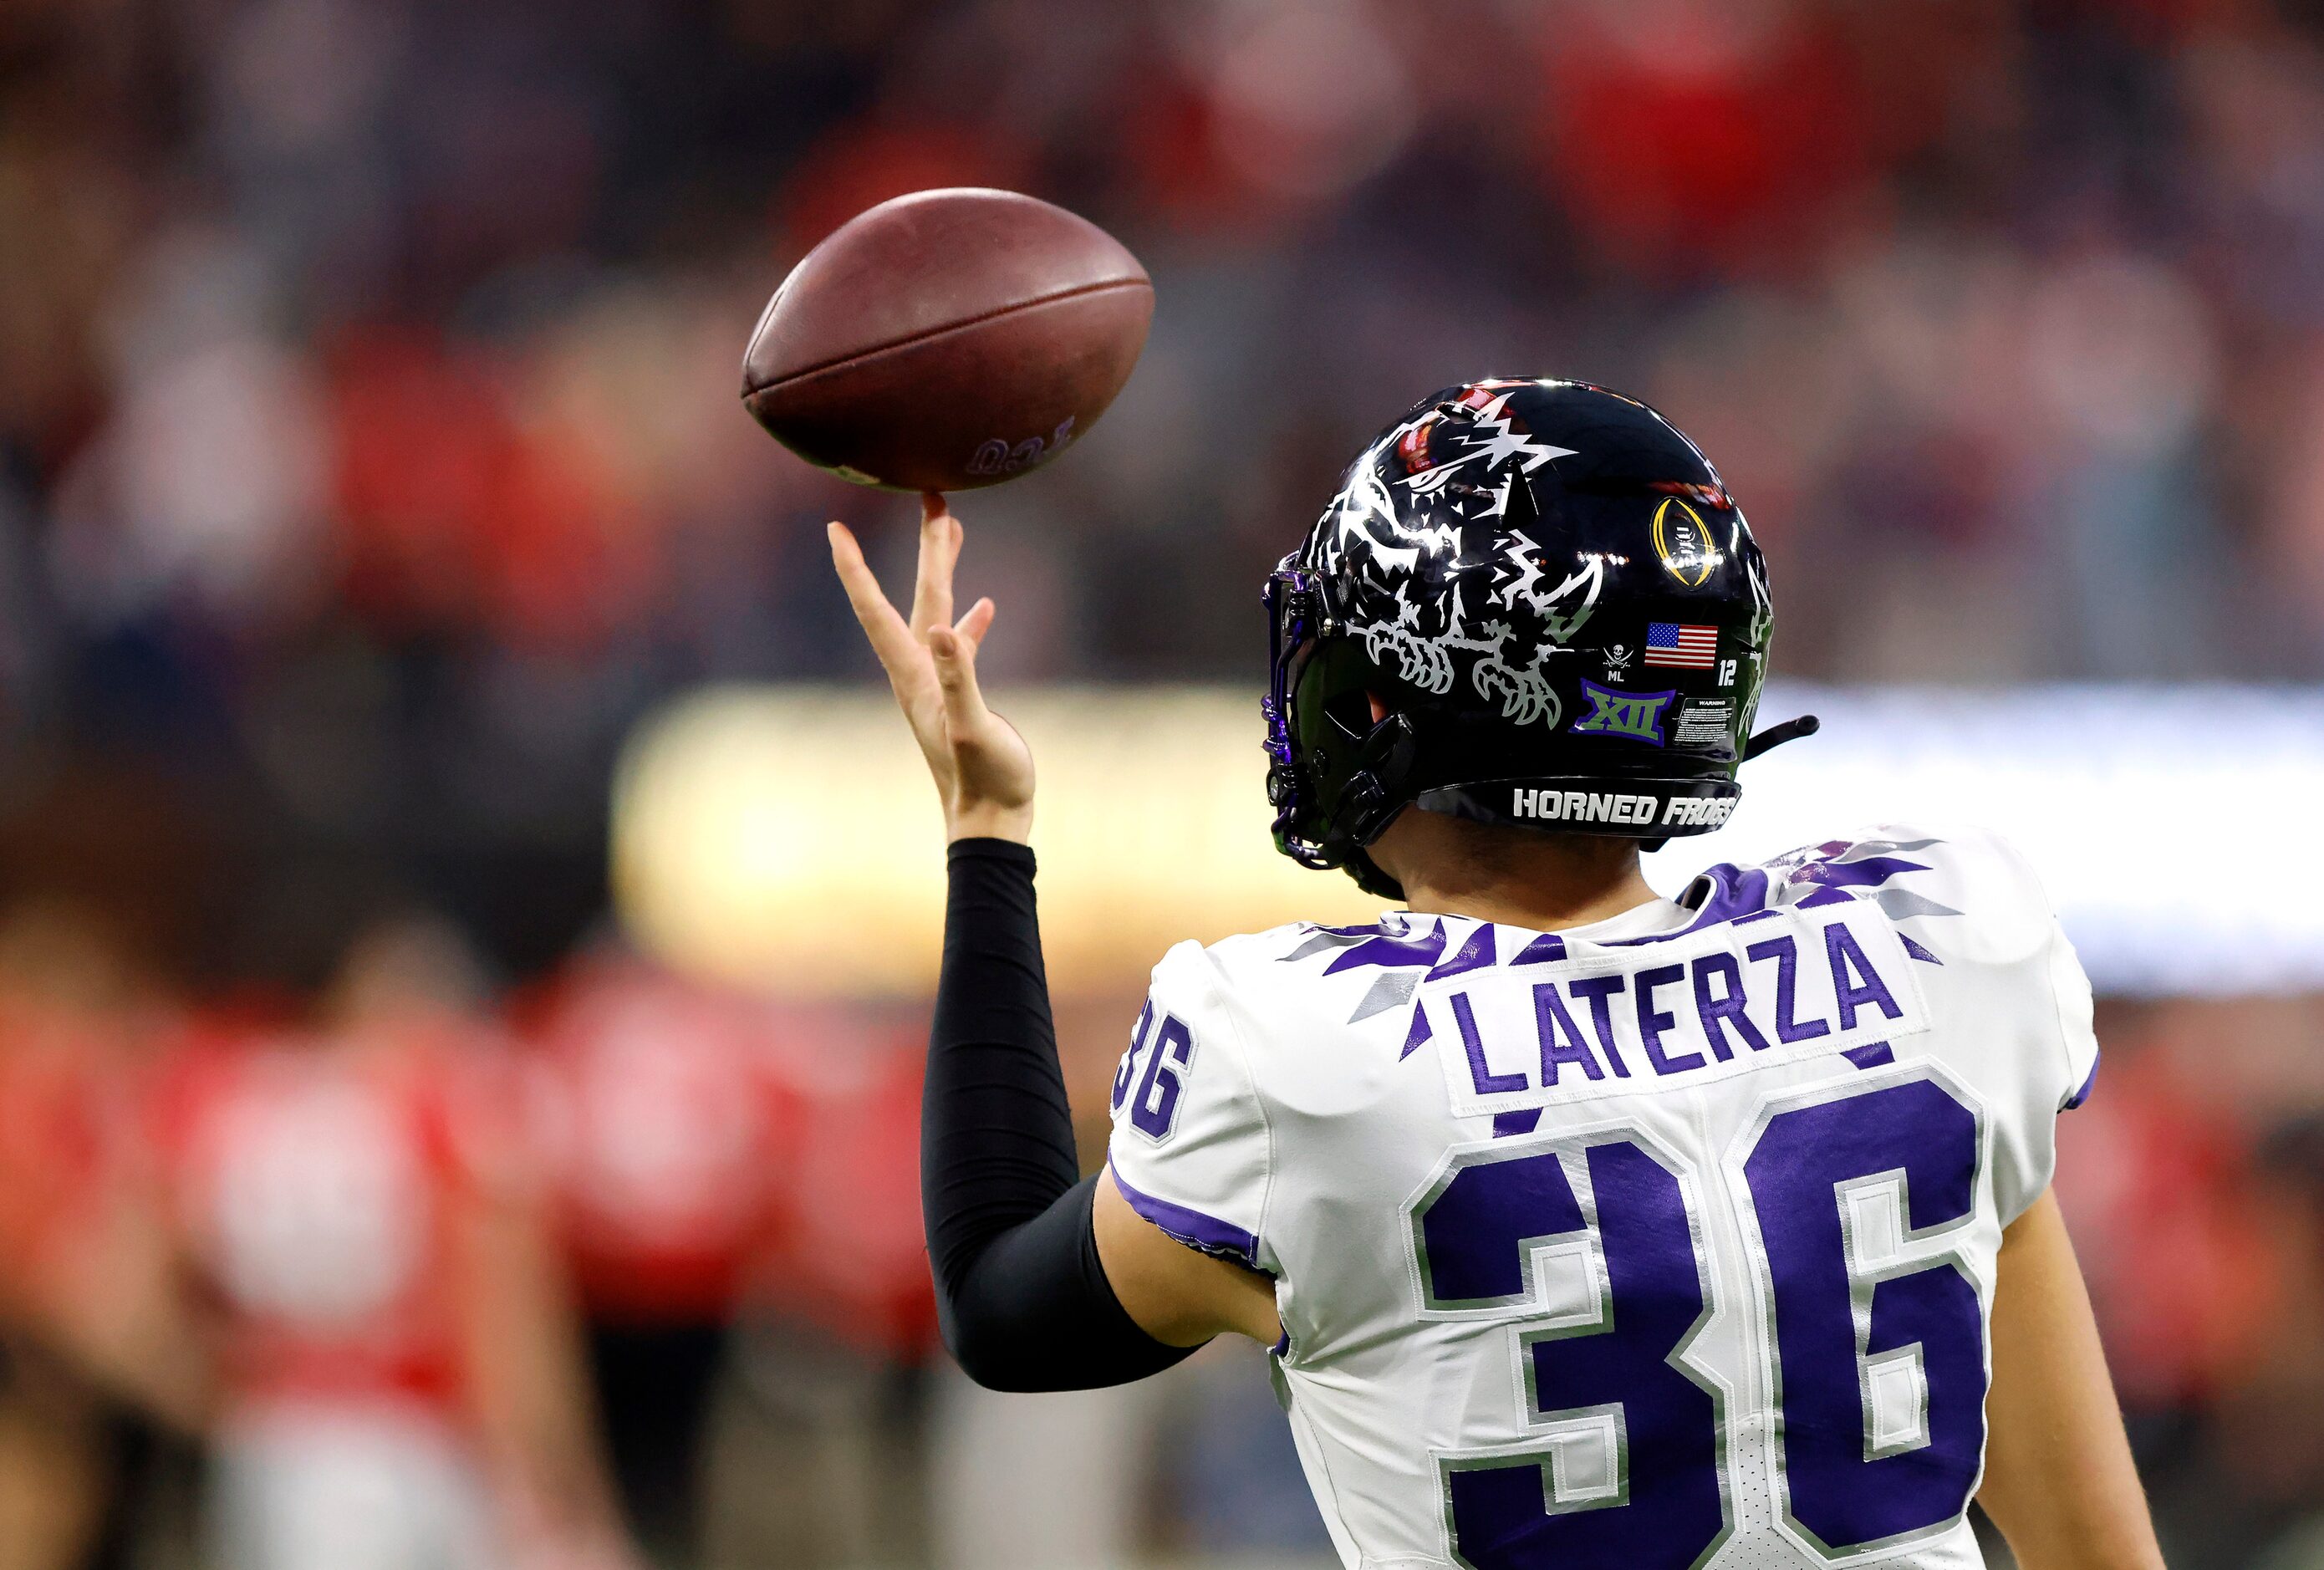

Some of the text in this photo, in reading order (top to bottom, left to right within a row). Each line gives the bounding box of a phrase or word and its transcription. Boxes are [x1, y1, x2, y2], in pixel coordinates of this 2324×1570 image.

[1608, 670, 1624, 682] ML
[1718, 659, 1737, 686] 12
[1578, 685, 1669, 742] XII
[1513, 788, 1658, 825] HORNED
[1449, 921, 1904, 1095] LATERZA
[1404, 1065, 1988, 1570] 36
